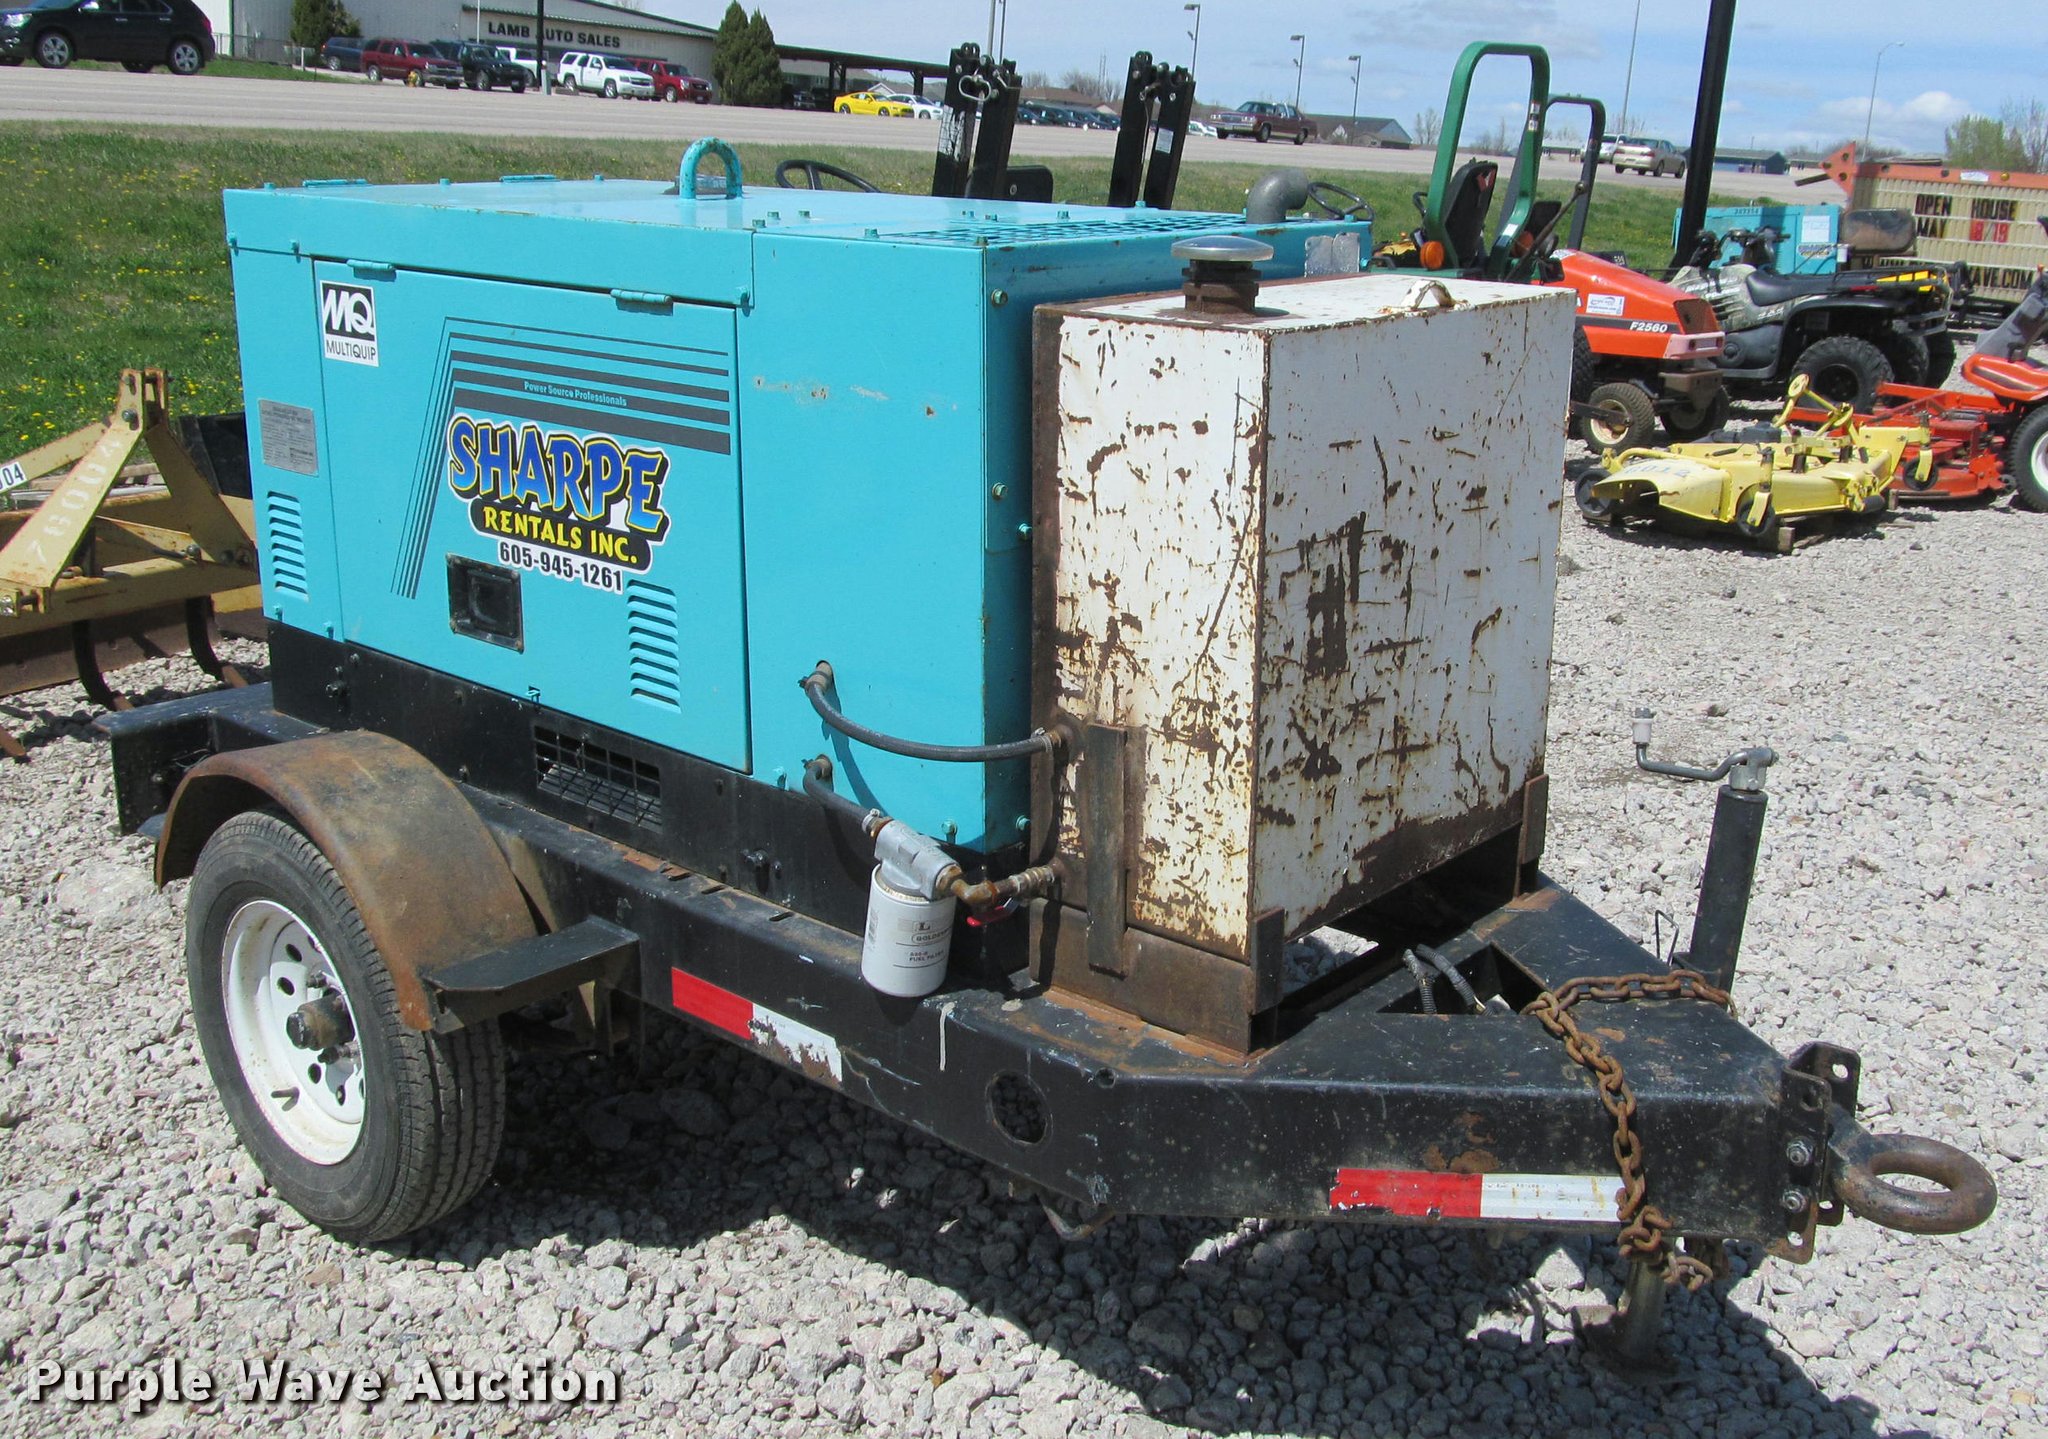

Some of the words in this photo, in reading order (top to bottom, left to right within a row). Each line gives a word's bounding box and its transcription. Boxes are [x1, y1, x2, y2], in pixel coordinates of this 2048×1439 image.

[488, 22, 530, 38] LAMB
[578, 32, 621, 48] SALES
[1914, 193, 1952, 216] OPEN
[1971, 197, 2017, 221] HOUSE
[1917, 217, 1947, 239] MAY
[324, 289, 375, 336] MQ
[1630, 321, 1668, 333] F2560
[326, 339, 377, 361] MULTIQUIP
[524, 381, 547, 394] Power
[548, 385, 574, 398] Source
[574, 389, 628, 407] Professionals
[0, 462, 25, 491] 04
[449, 415, 668, 537] SHARPE
[482, 506, 582, 550] RENTALS
[590, 530, 639, 564] INC.
[500, 542, 622, 591] 605-945-1261
